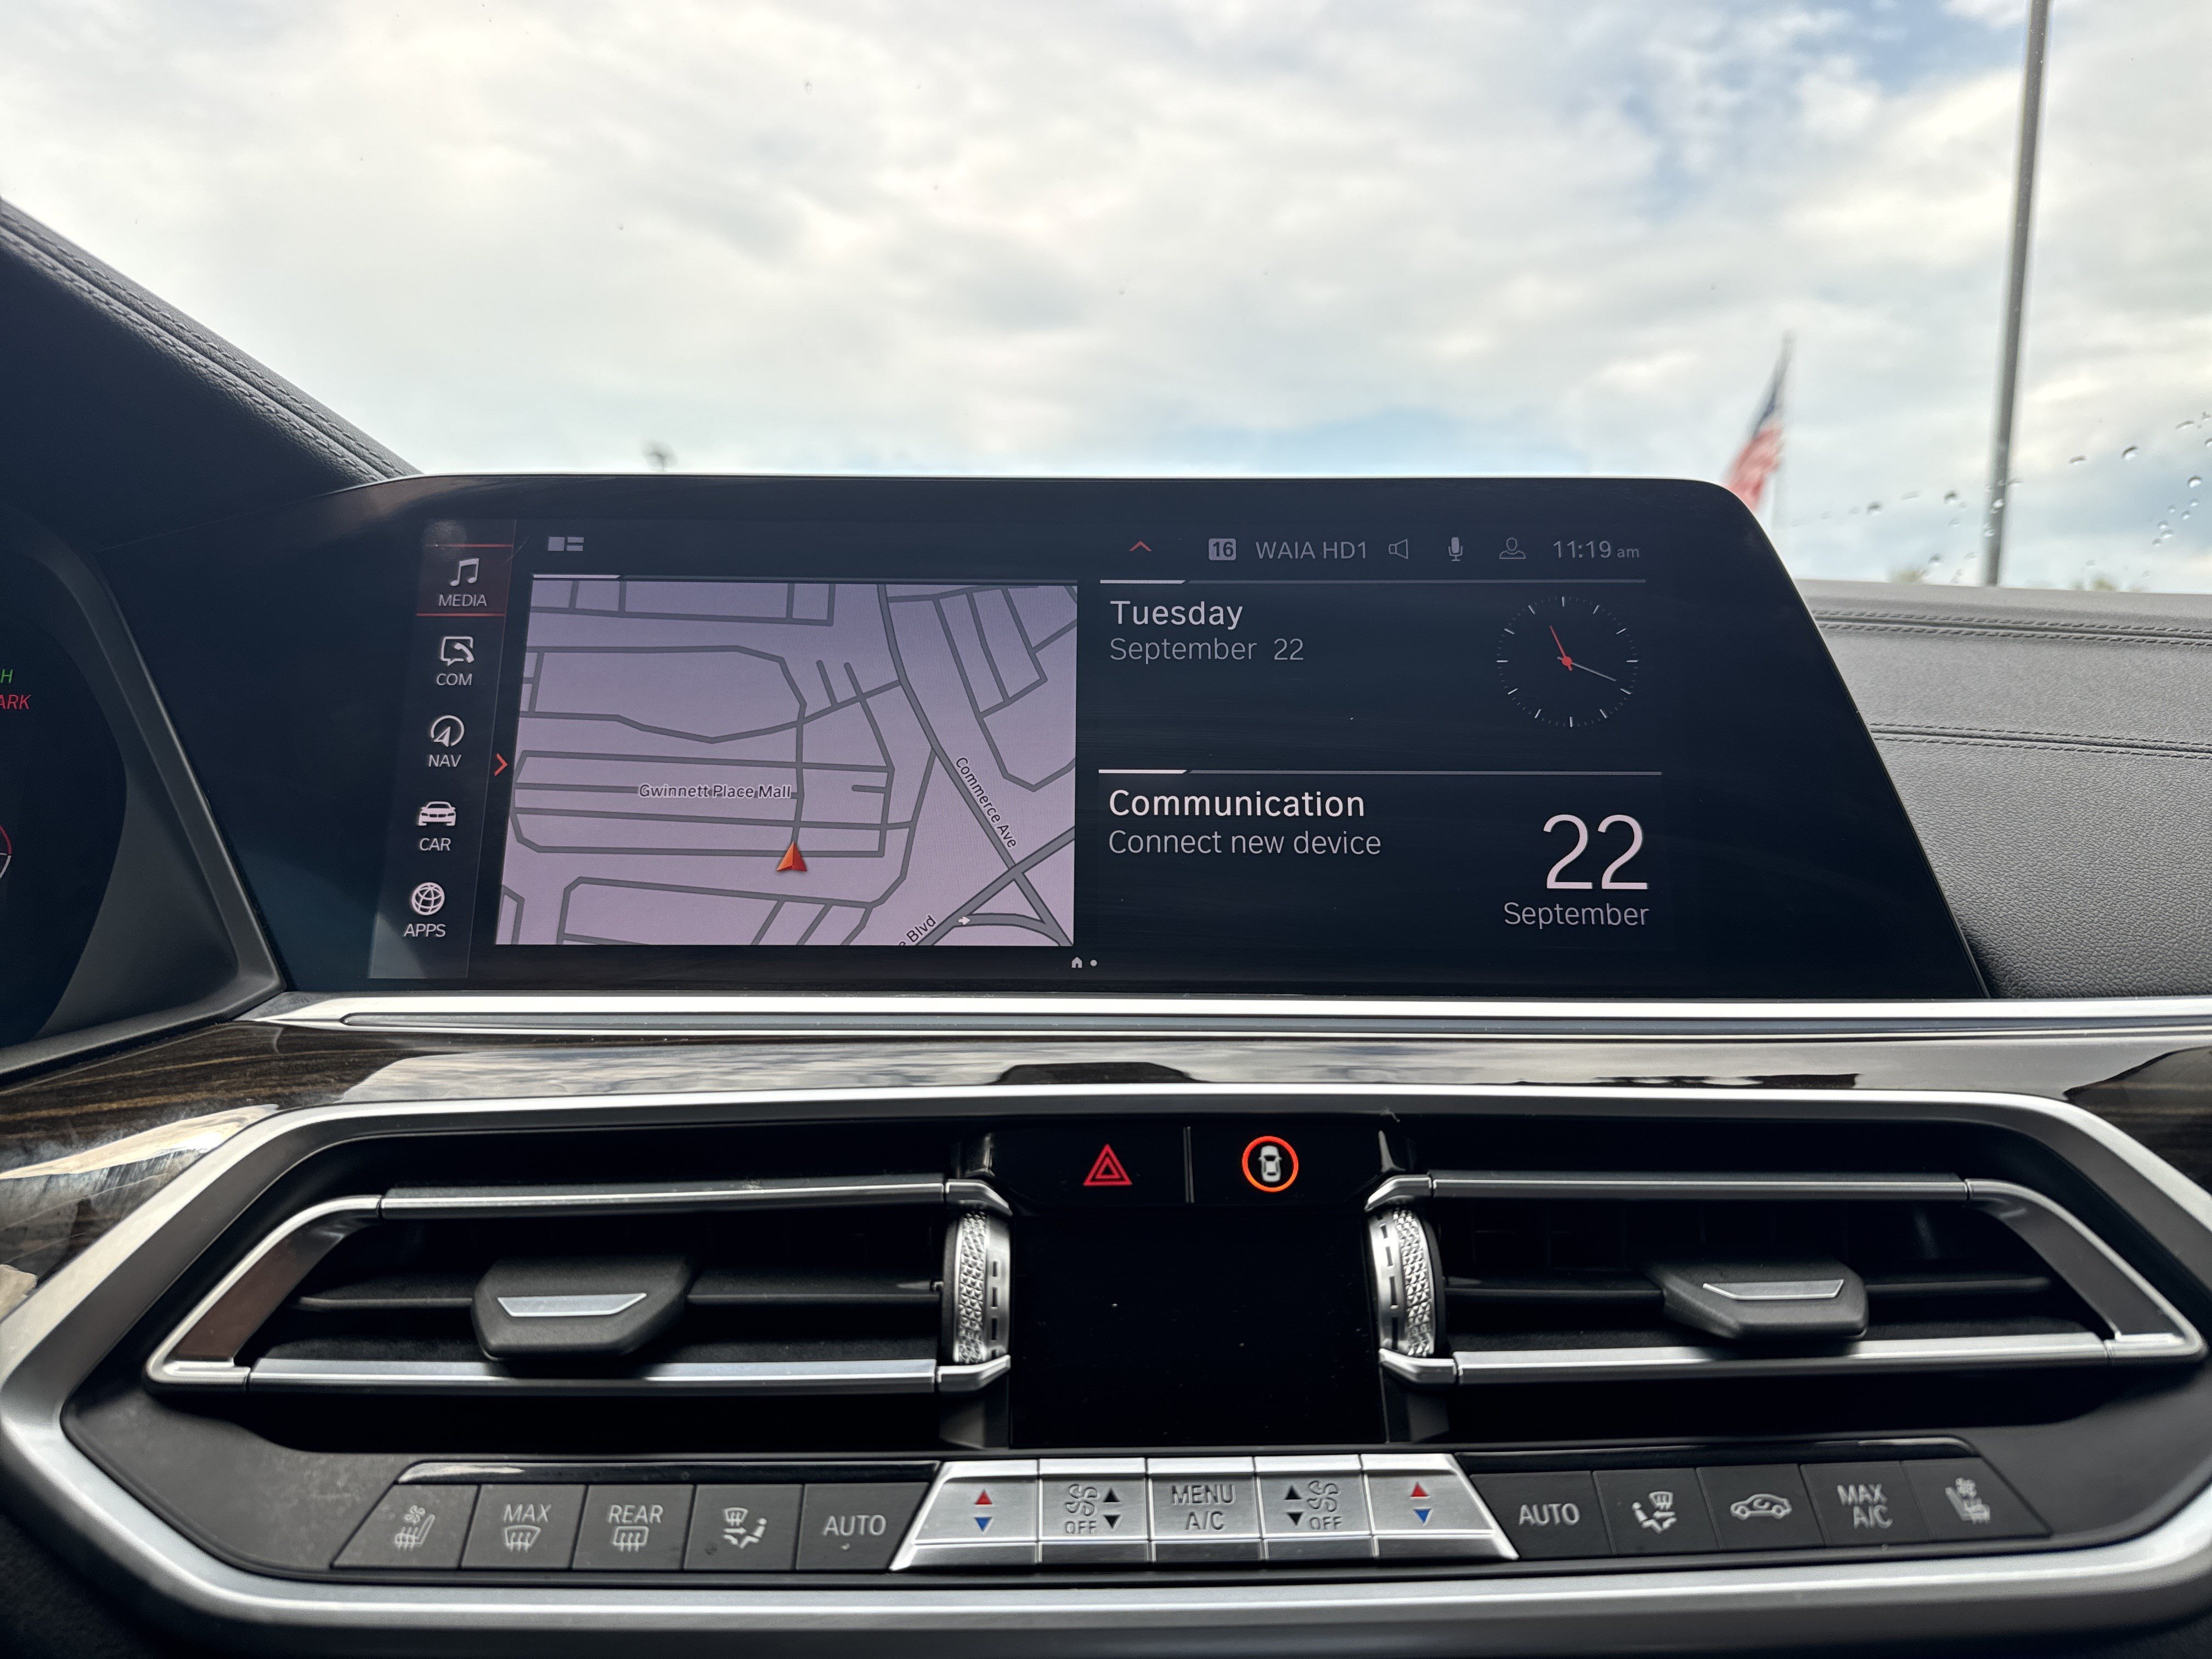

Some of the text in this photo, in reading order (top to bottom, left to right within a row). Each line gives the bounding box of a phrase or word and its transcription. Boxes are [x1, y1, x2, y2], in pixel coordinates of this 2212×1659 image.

[1213, 541, 1367, 559] 16 WAIA HD1
[1553, 540, 1640, 558] 11:19 am
[438, 594, 487, 607] MEDIA
[1110, 600, 1243, 630] Tuesday
[1110, 637, 1304, 665] September 22
[436, 673, 473, 686] COM
[428, 754, 462, 768] NAV
[639, 784, 791, 798] Gwinnett Place Mall
[956, 757, 1017, 848] Commerce Ave
[1109, 789, 1365, 817] Communication
[419, 837, 451, 851] CAR
[1109, 830, 1381, 855] Connect new device
[1543, 814, 1648, 890] 22
[1504, 902, 1650, 930] September
[403, 923, 446, 938] APPS
[906, 915, 936, 943] Blvd
[1172, 1483, 1235, 1505] MENU
[1837, 1483, 1885, 1506] MAX
[503, 1504, 552, 1523] MAX
[608, 1504, 664, 1523] REAR
[1186, 1510, 1225, 1531] A/C
[1310, 1515, 1342, 1531] OFF
[1519, 1503, 1581, 1527] AUTO
[1852, 1505, 1893, 1530] A/C
[823, 1515, 887, 1537] AUTO
[1065, 1520, 1097, 1536] OFF
